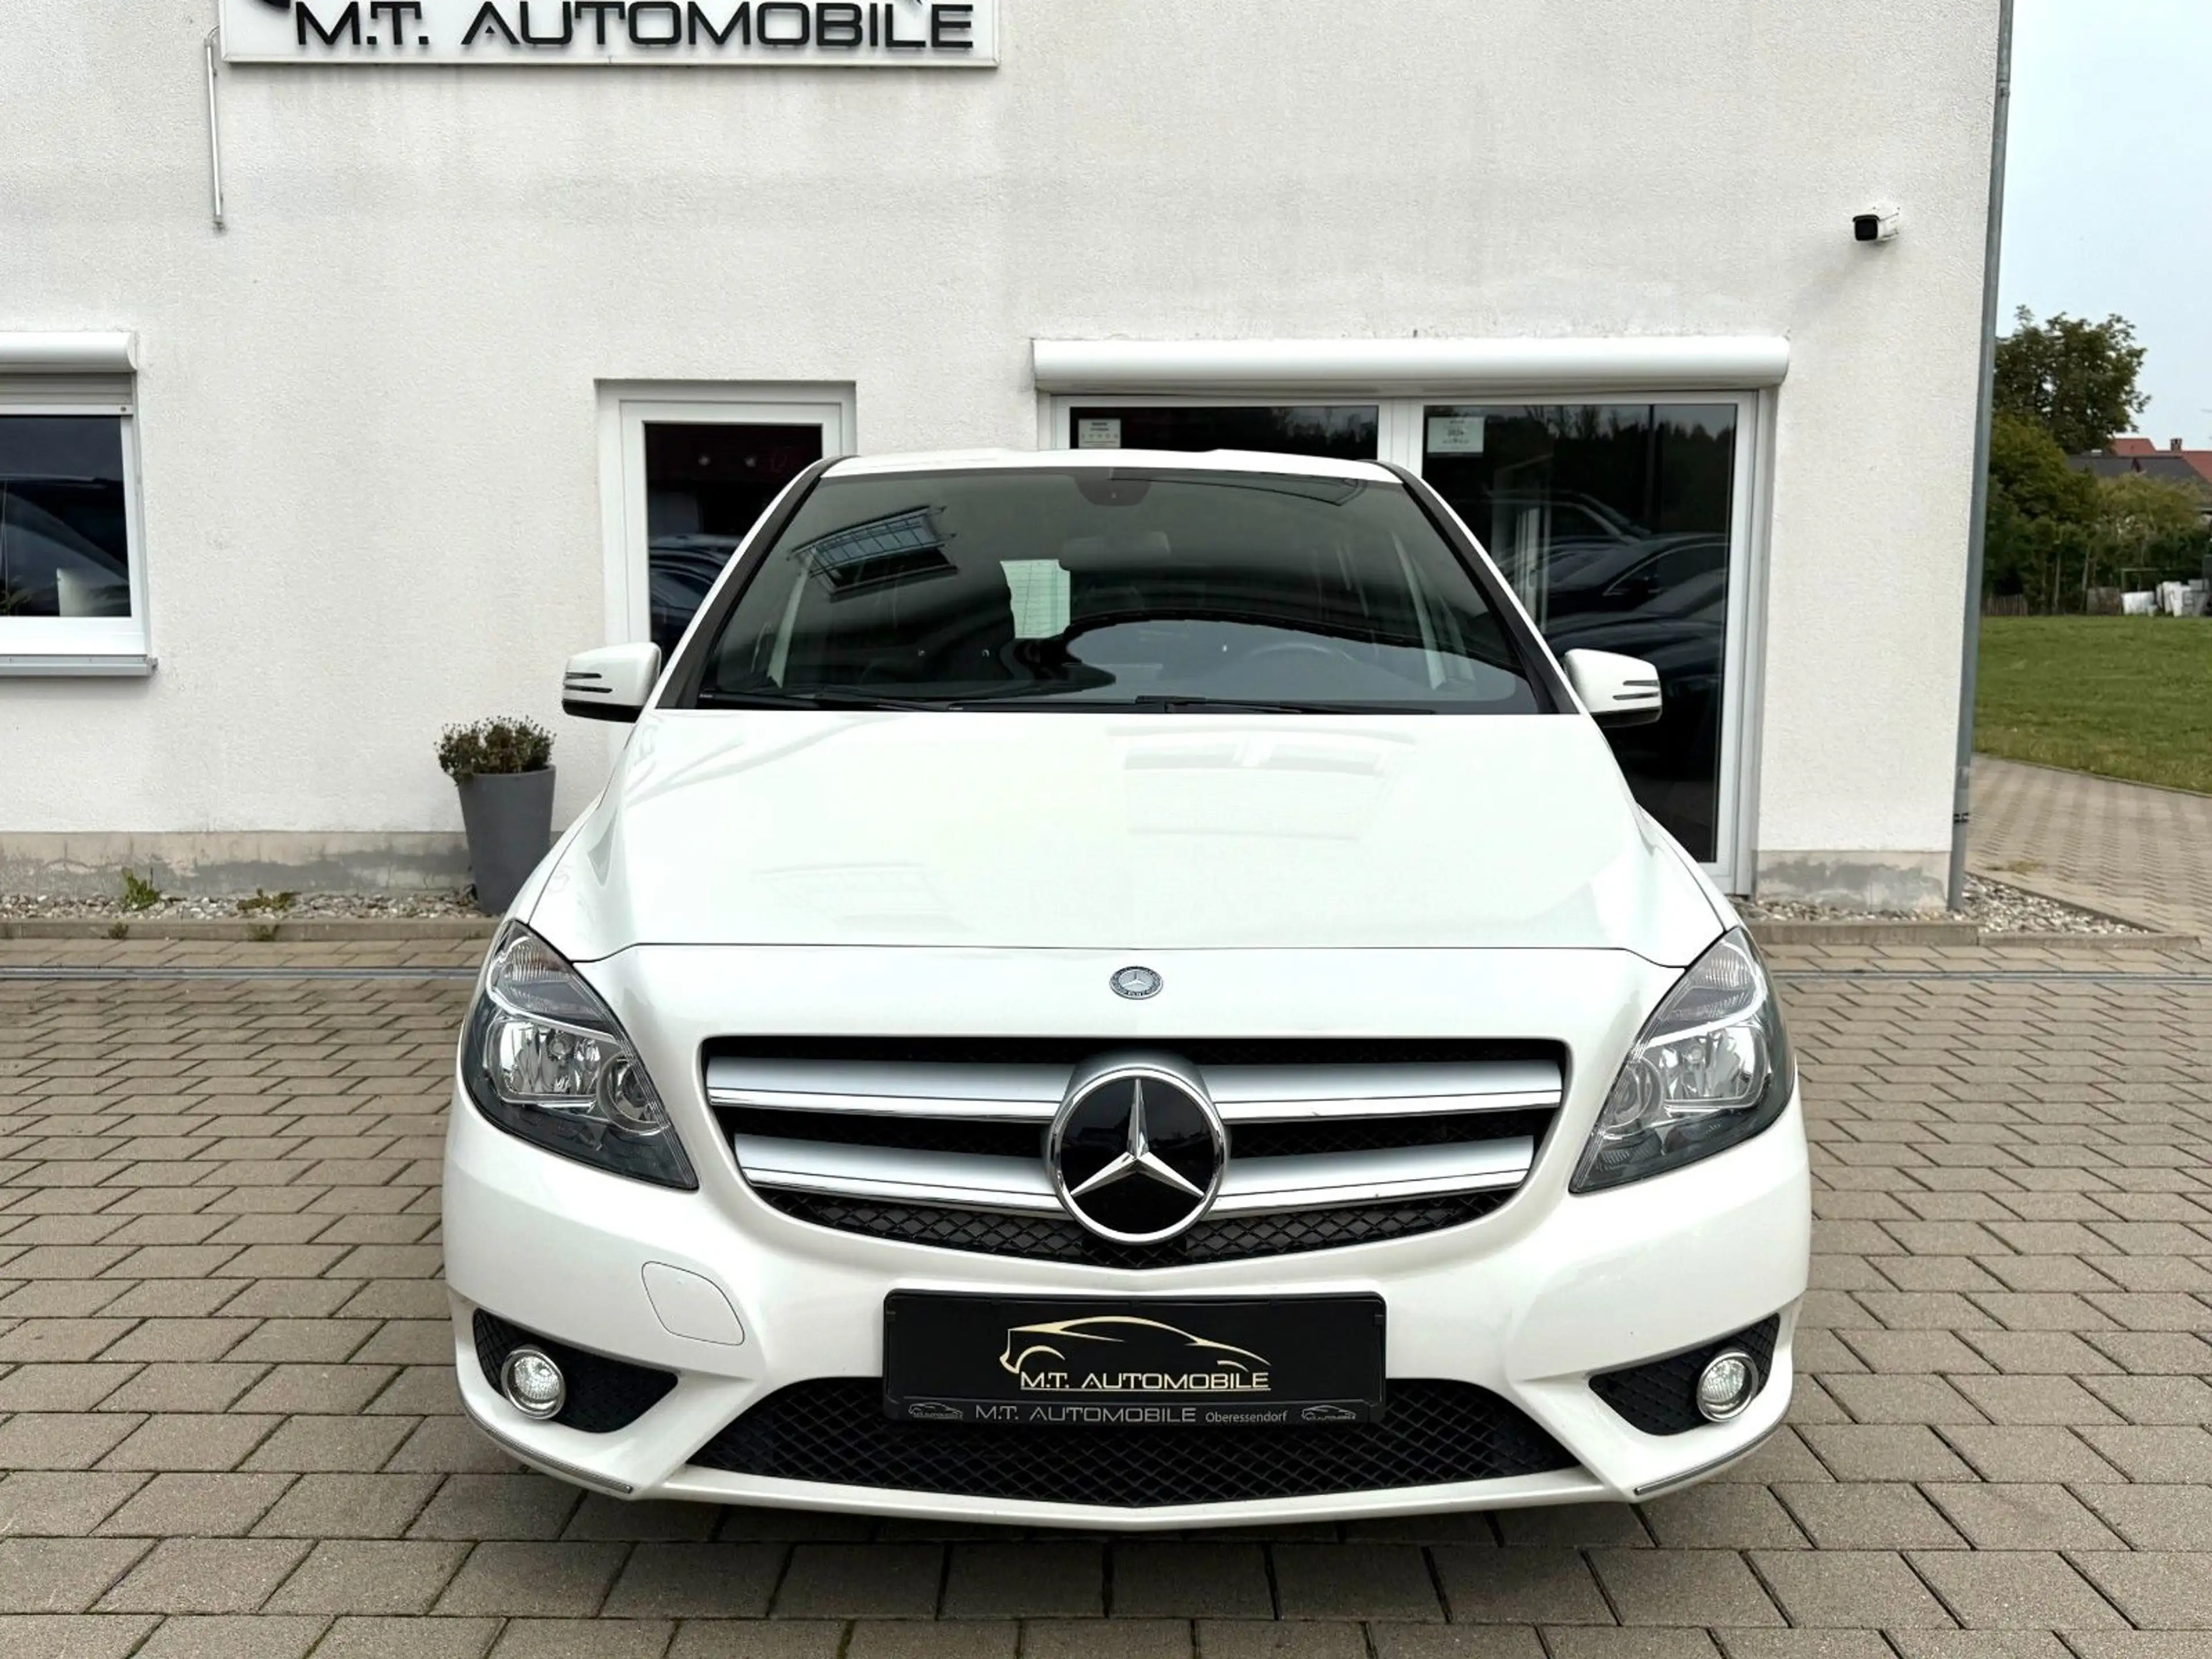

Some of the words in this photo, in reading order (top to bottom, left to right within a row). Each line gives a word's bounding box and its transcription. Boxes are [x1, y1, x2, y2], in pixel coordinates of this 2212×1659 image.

[295, 1, 429, 45] M.T.
[461, 1, 974, 48] AUTOMOBILE
[1020, 1372, 1070, 1389] M.T.
[1081, 1372, 1269, 1389] AUTOMOBILE
[976, 1404, 1019, 1419] M.T.
[1029, 1406, 1197, 1422] AUTOMOBILE
[1205, 1410, 1288, 1423] Oberessendorf
